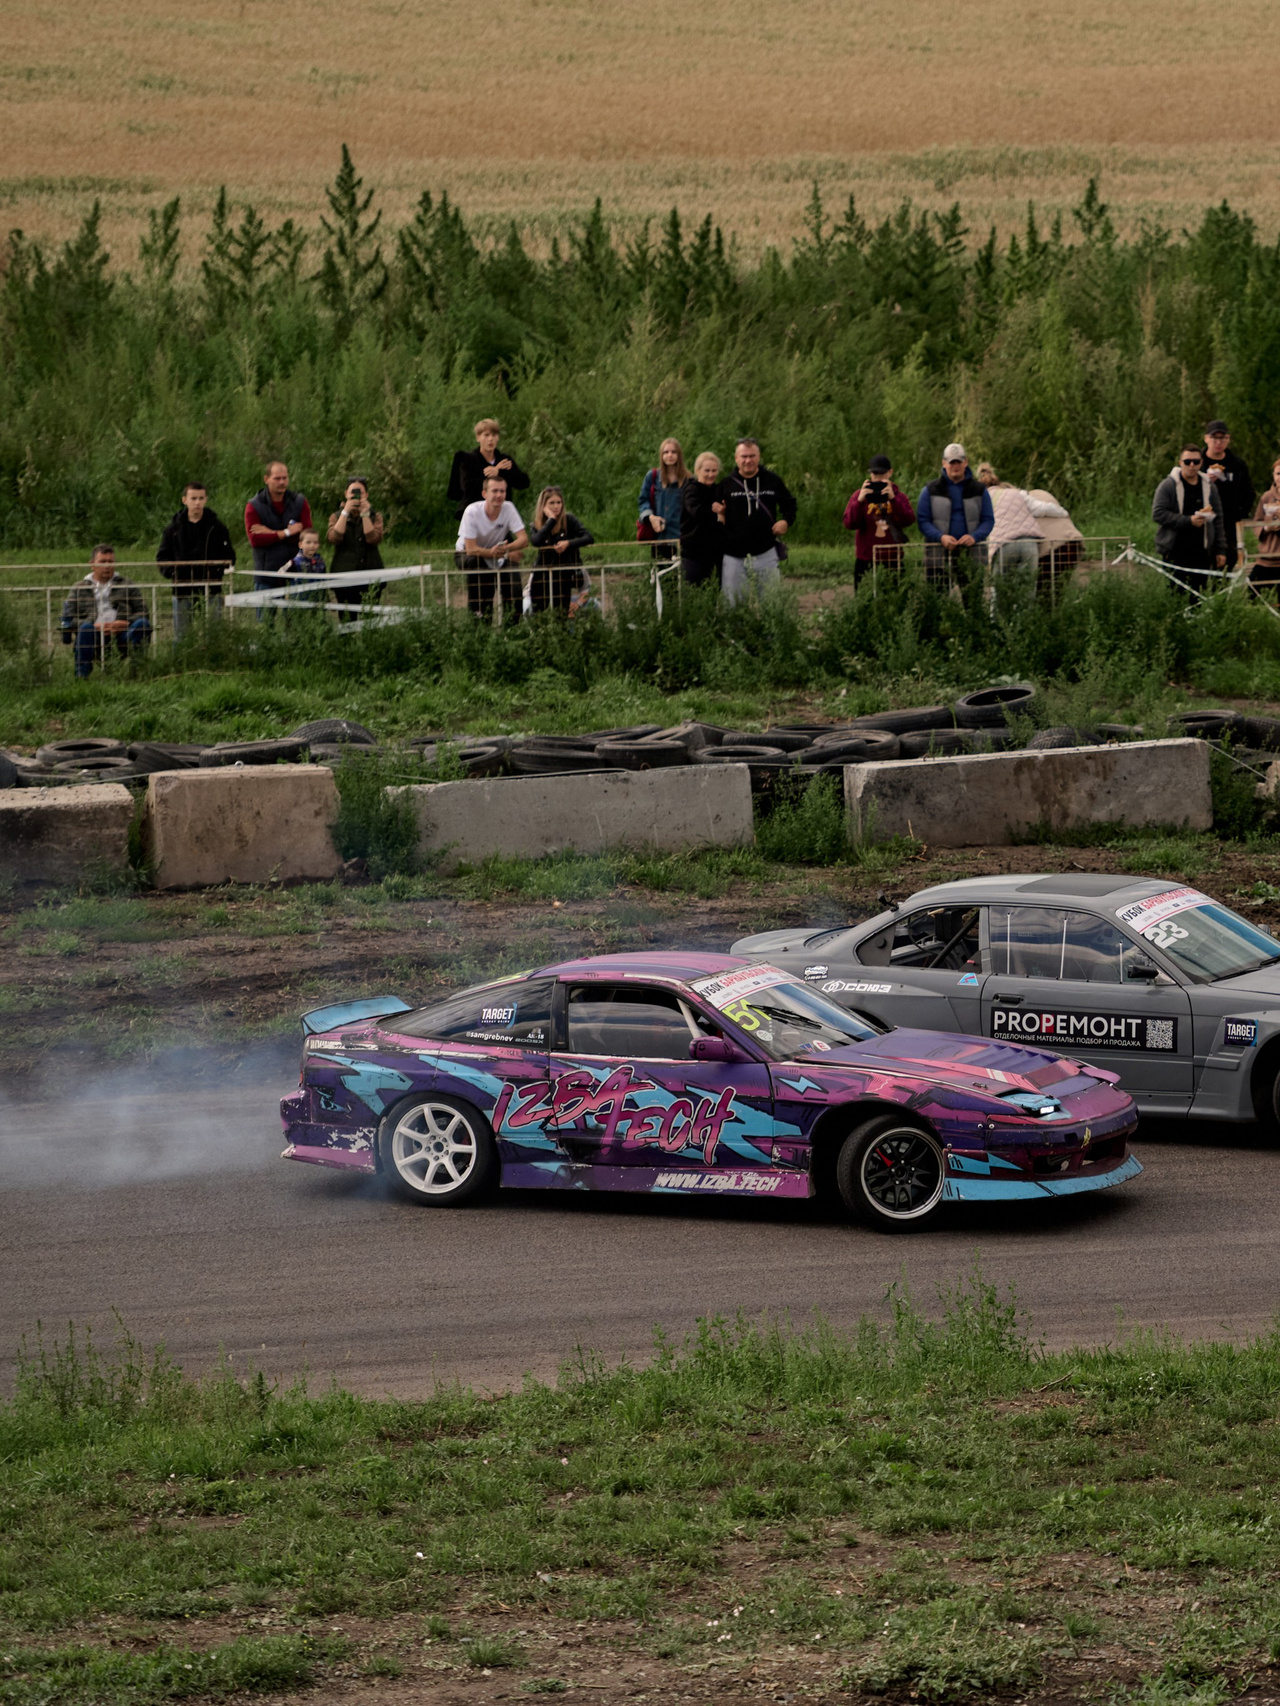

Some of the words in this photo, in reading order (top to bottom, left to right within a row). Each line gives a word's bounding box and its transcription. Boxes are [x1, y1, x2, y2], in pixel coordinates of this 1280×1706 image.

[1120, 904, 1147, 923] КУБОК
[1144, 920, 1189, 950] 23
[698, 981, 725, 998] КУБОК
[844, 982, 892, 994] СОЮЗ
[481, 1008, 514, 1020] TARGET
[722, 999, 772, 1031] 51
[1227, 1023, 1256, 1037] TARGET
[993, 1032, 1036, 1041] ОТДЕЛОЧНЫЕ
[1076, 1037, 1103, 1045] ПОДБОР
[1109, 1039, 1141, 1047] ПРОДАЖА
[594, 1086, 736, 1167] TECH
[653, 1172, 781, 1192] WWW.IZBA.TECH
